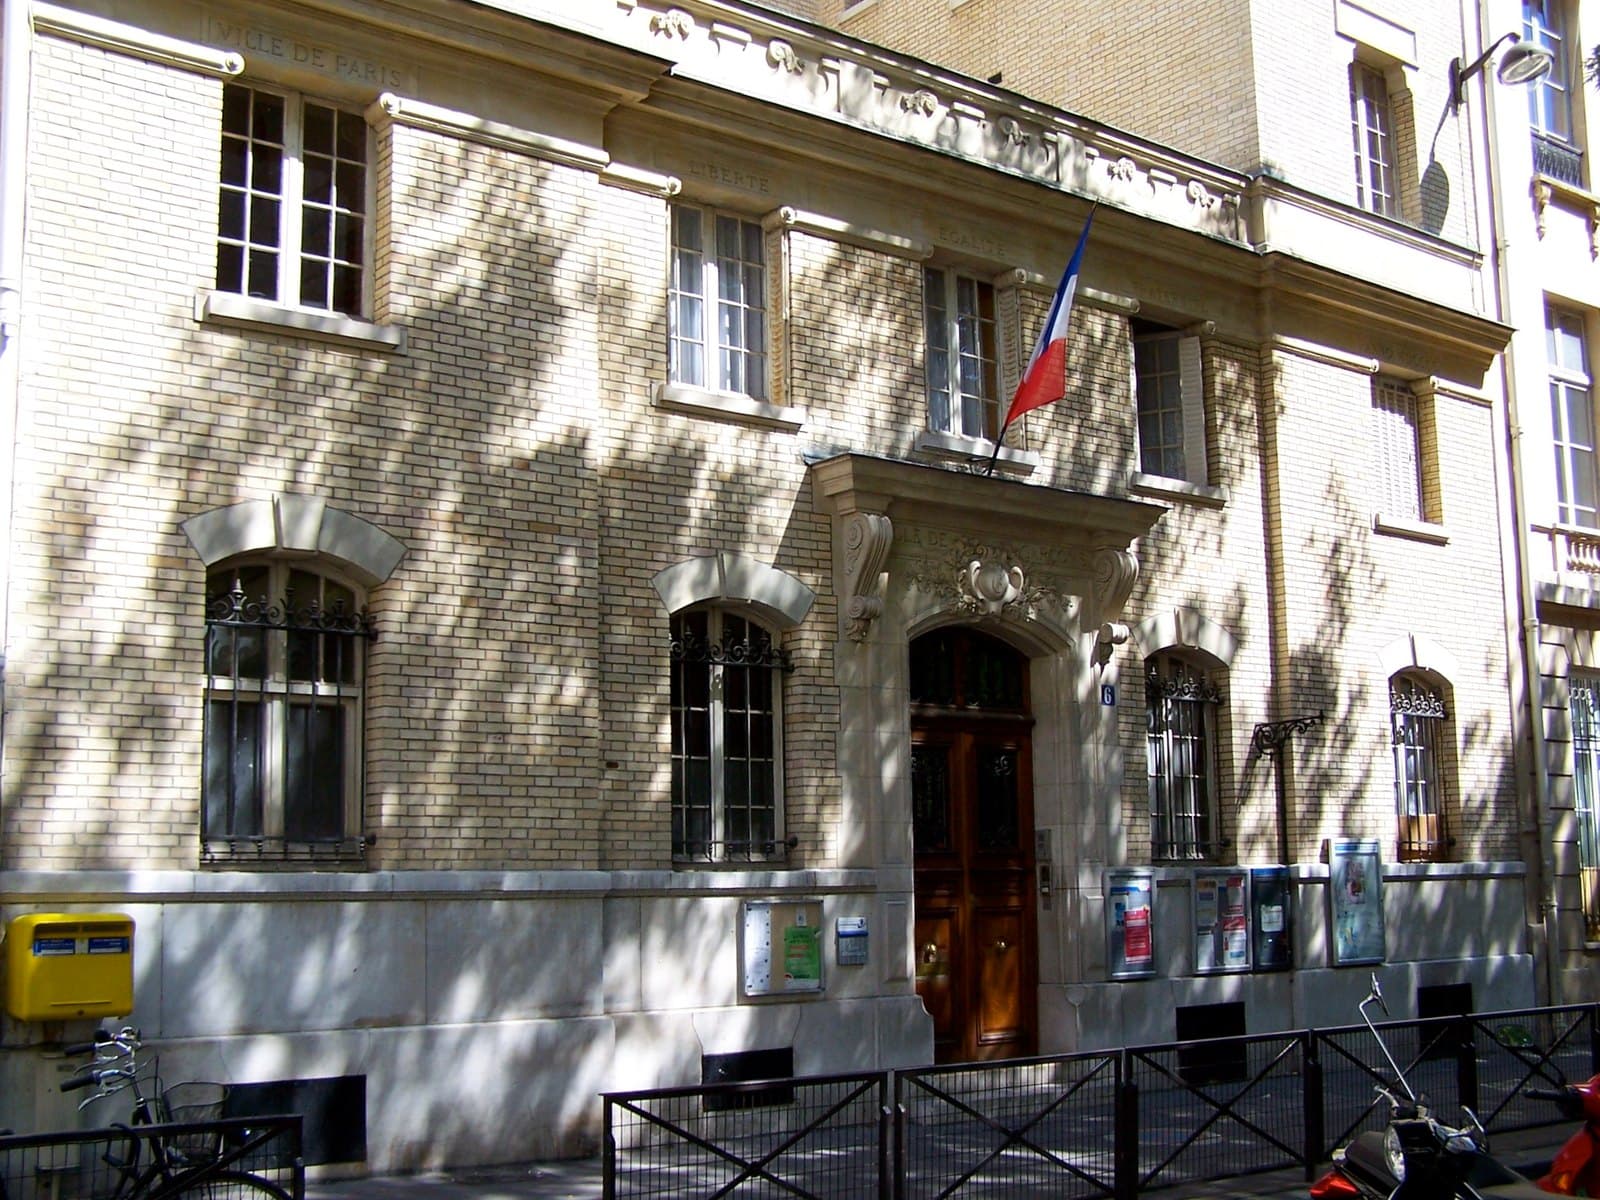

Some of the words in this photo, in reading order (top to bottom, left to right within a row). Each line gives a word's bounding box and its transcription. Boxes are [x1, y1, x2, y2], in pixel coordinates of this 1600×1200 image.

[216, 21, 283, 57] VILLE
[293, 44, 325, 68] DE
[335, 55, 401, 87] PARIS
[1104, 687, 1112, 704] 6
